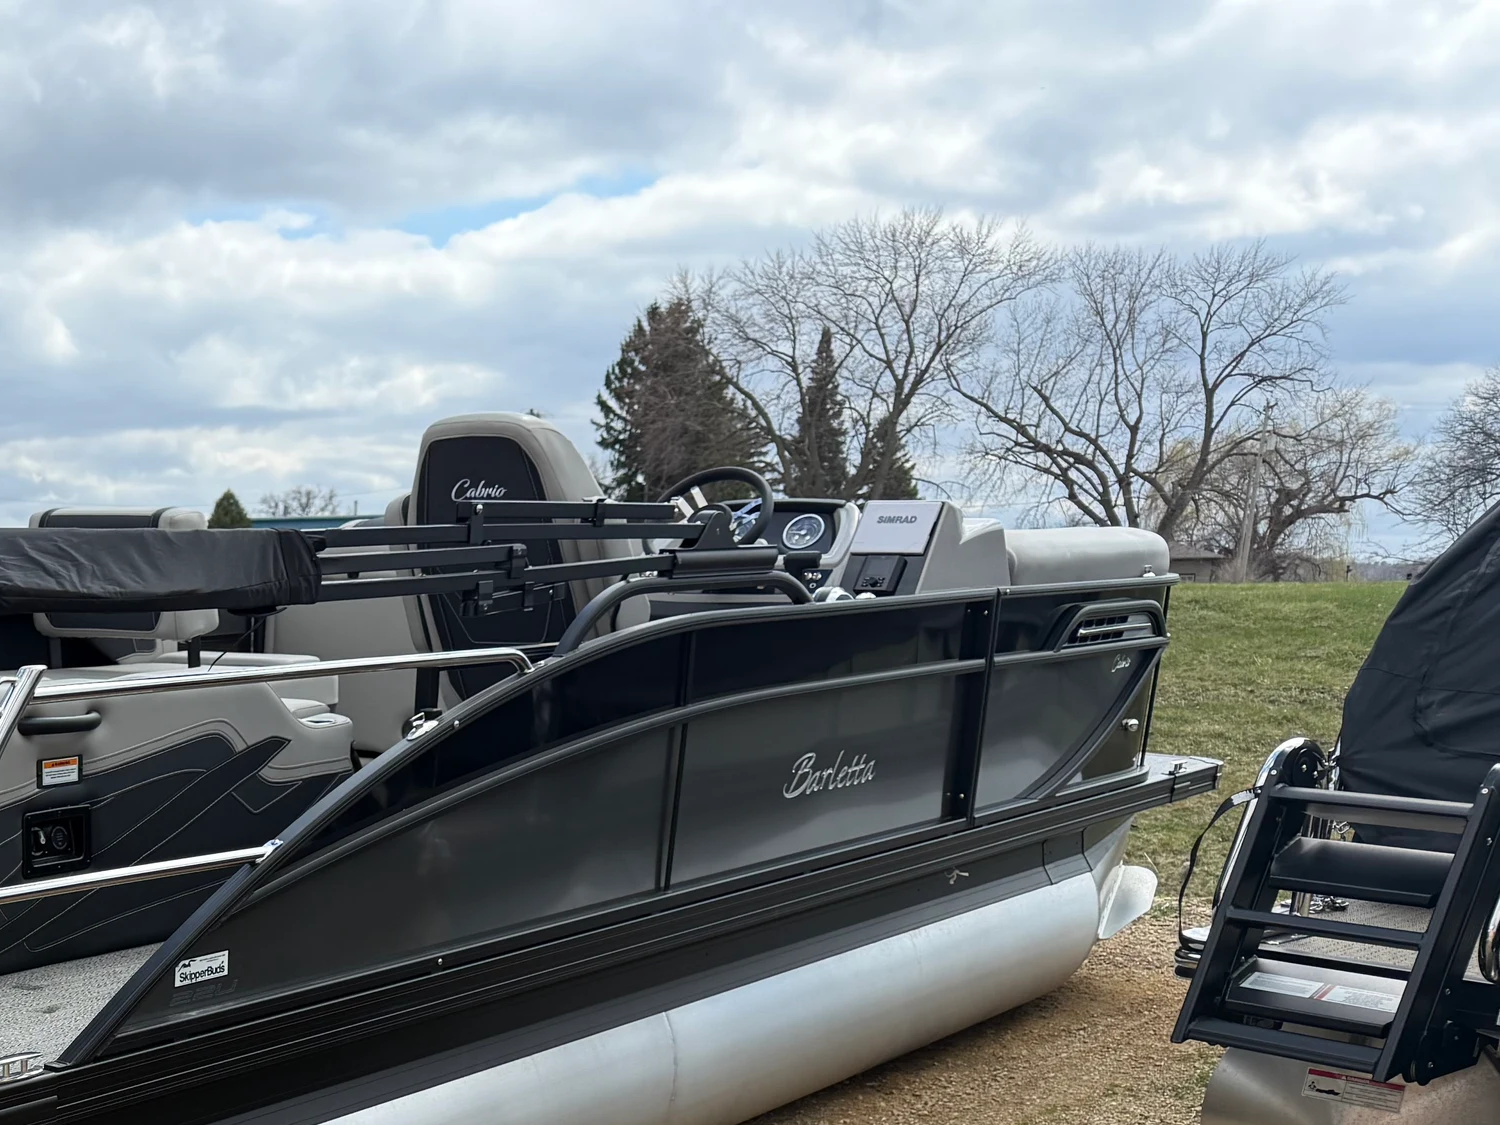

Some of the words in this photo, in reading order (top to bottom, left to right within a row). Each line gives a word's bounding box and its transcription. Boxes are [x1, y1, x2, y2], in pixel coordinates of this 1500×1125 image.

[451, 478, 507, 501] Cabrio
[877, 515, 917, 524] SIMRAD
[783, 749, 876, 799] Barletta
